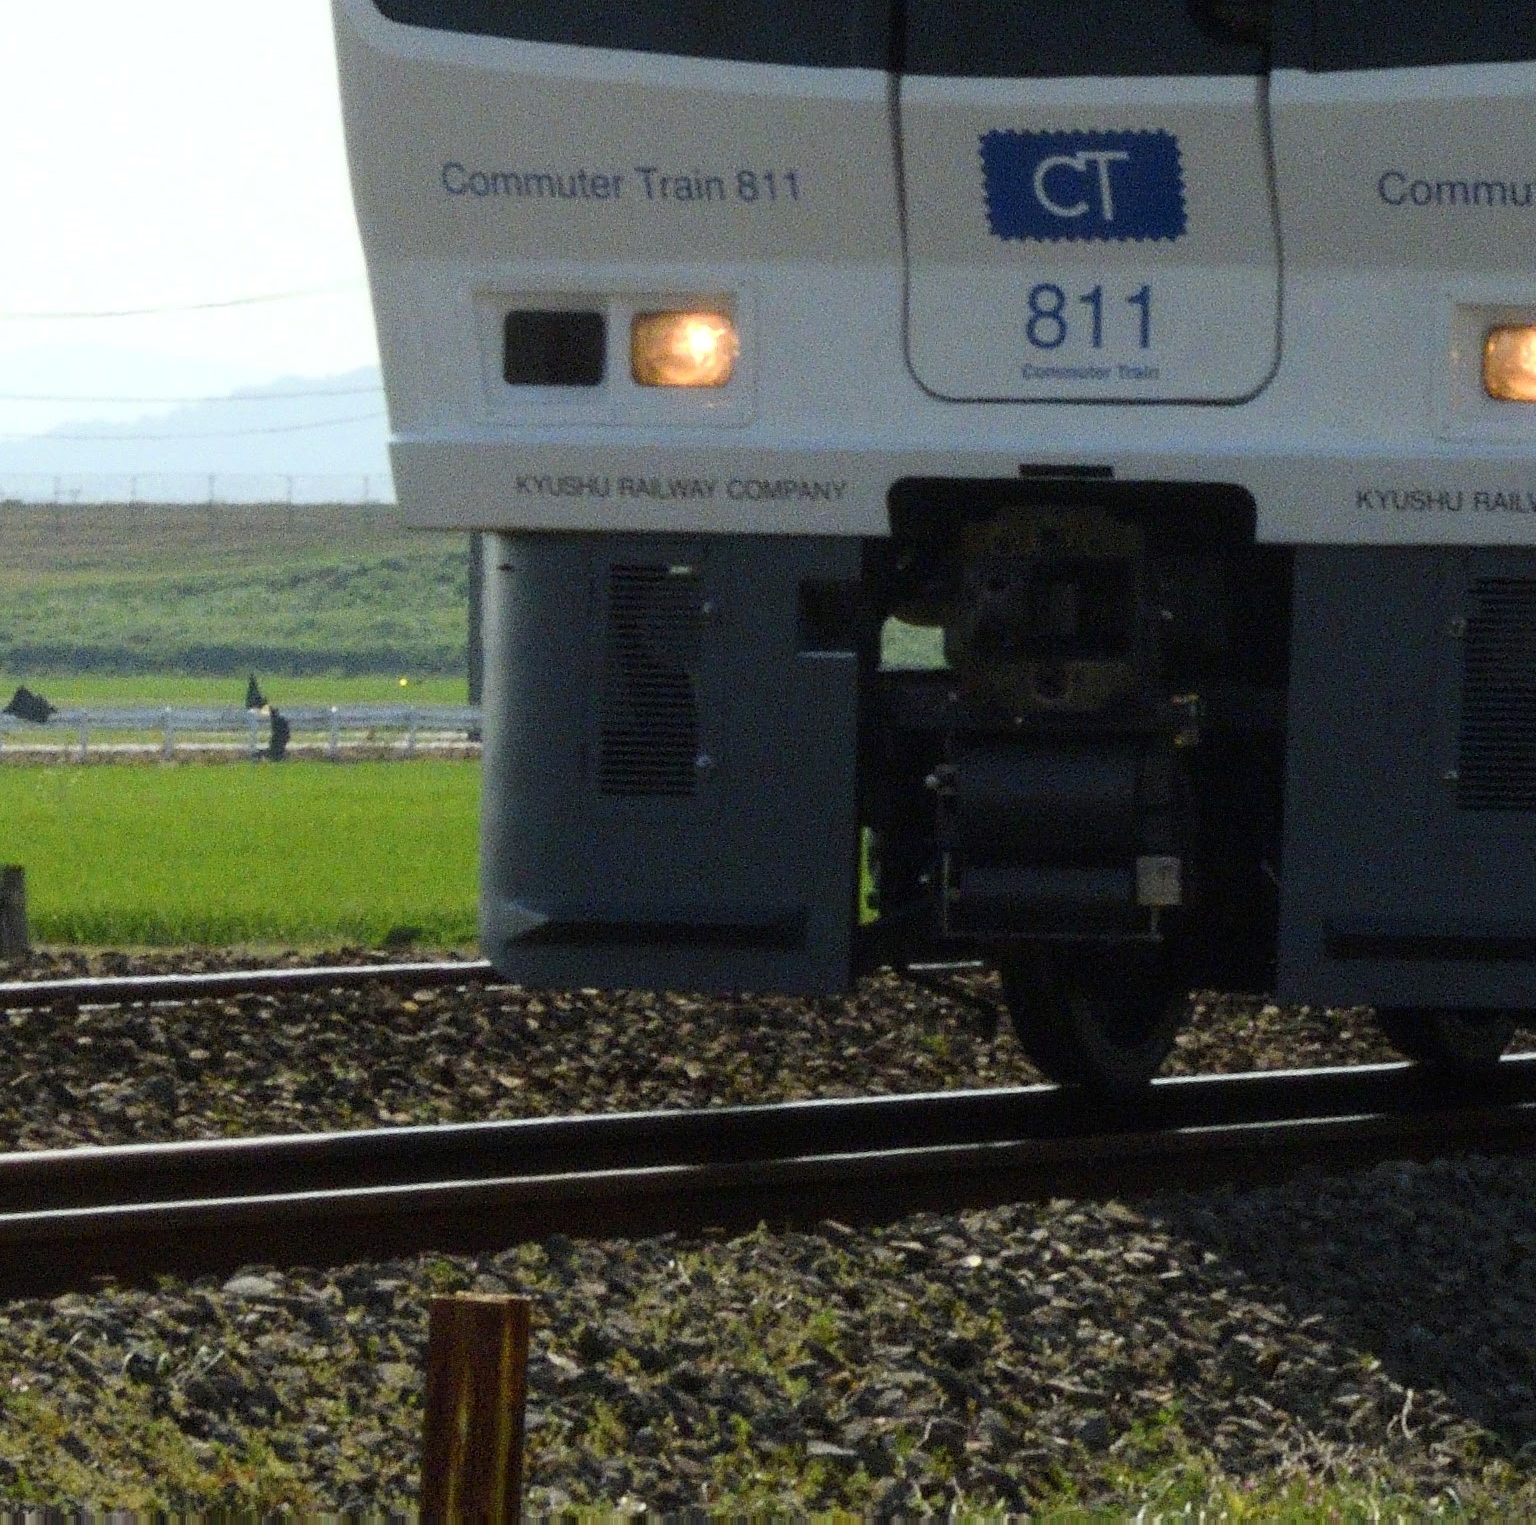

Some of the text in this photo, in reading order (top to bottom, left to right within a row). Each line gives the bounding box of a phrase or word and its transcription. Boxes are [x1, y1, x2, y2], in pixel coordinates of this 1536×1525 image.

[440, 160, 801, 204] Commuter Train 811
[1033, 150, 1131, 223] CT
[1025, 282, 1152, 351] 811
[514, 473, 850, 503] KYUSHU RAILWAY COMPANY
[1354, 489, 1465, 513] KYUSHU
